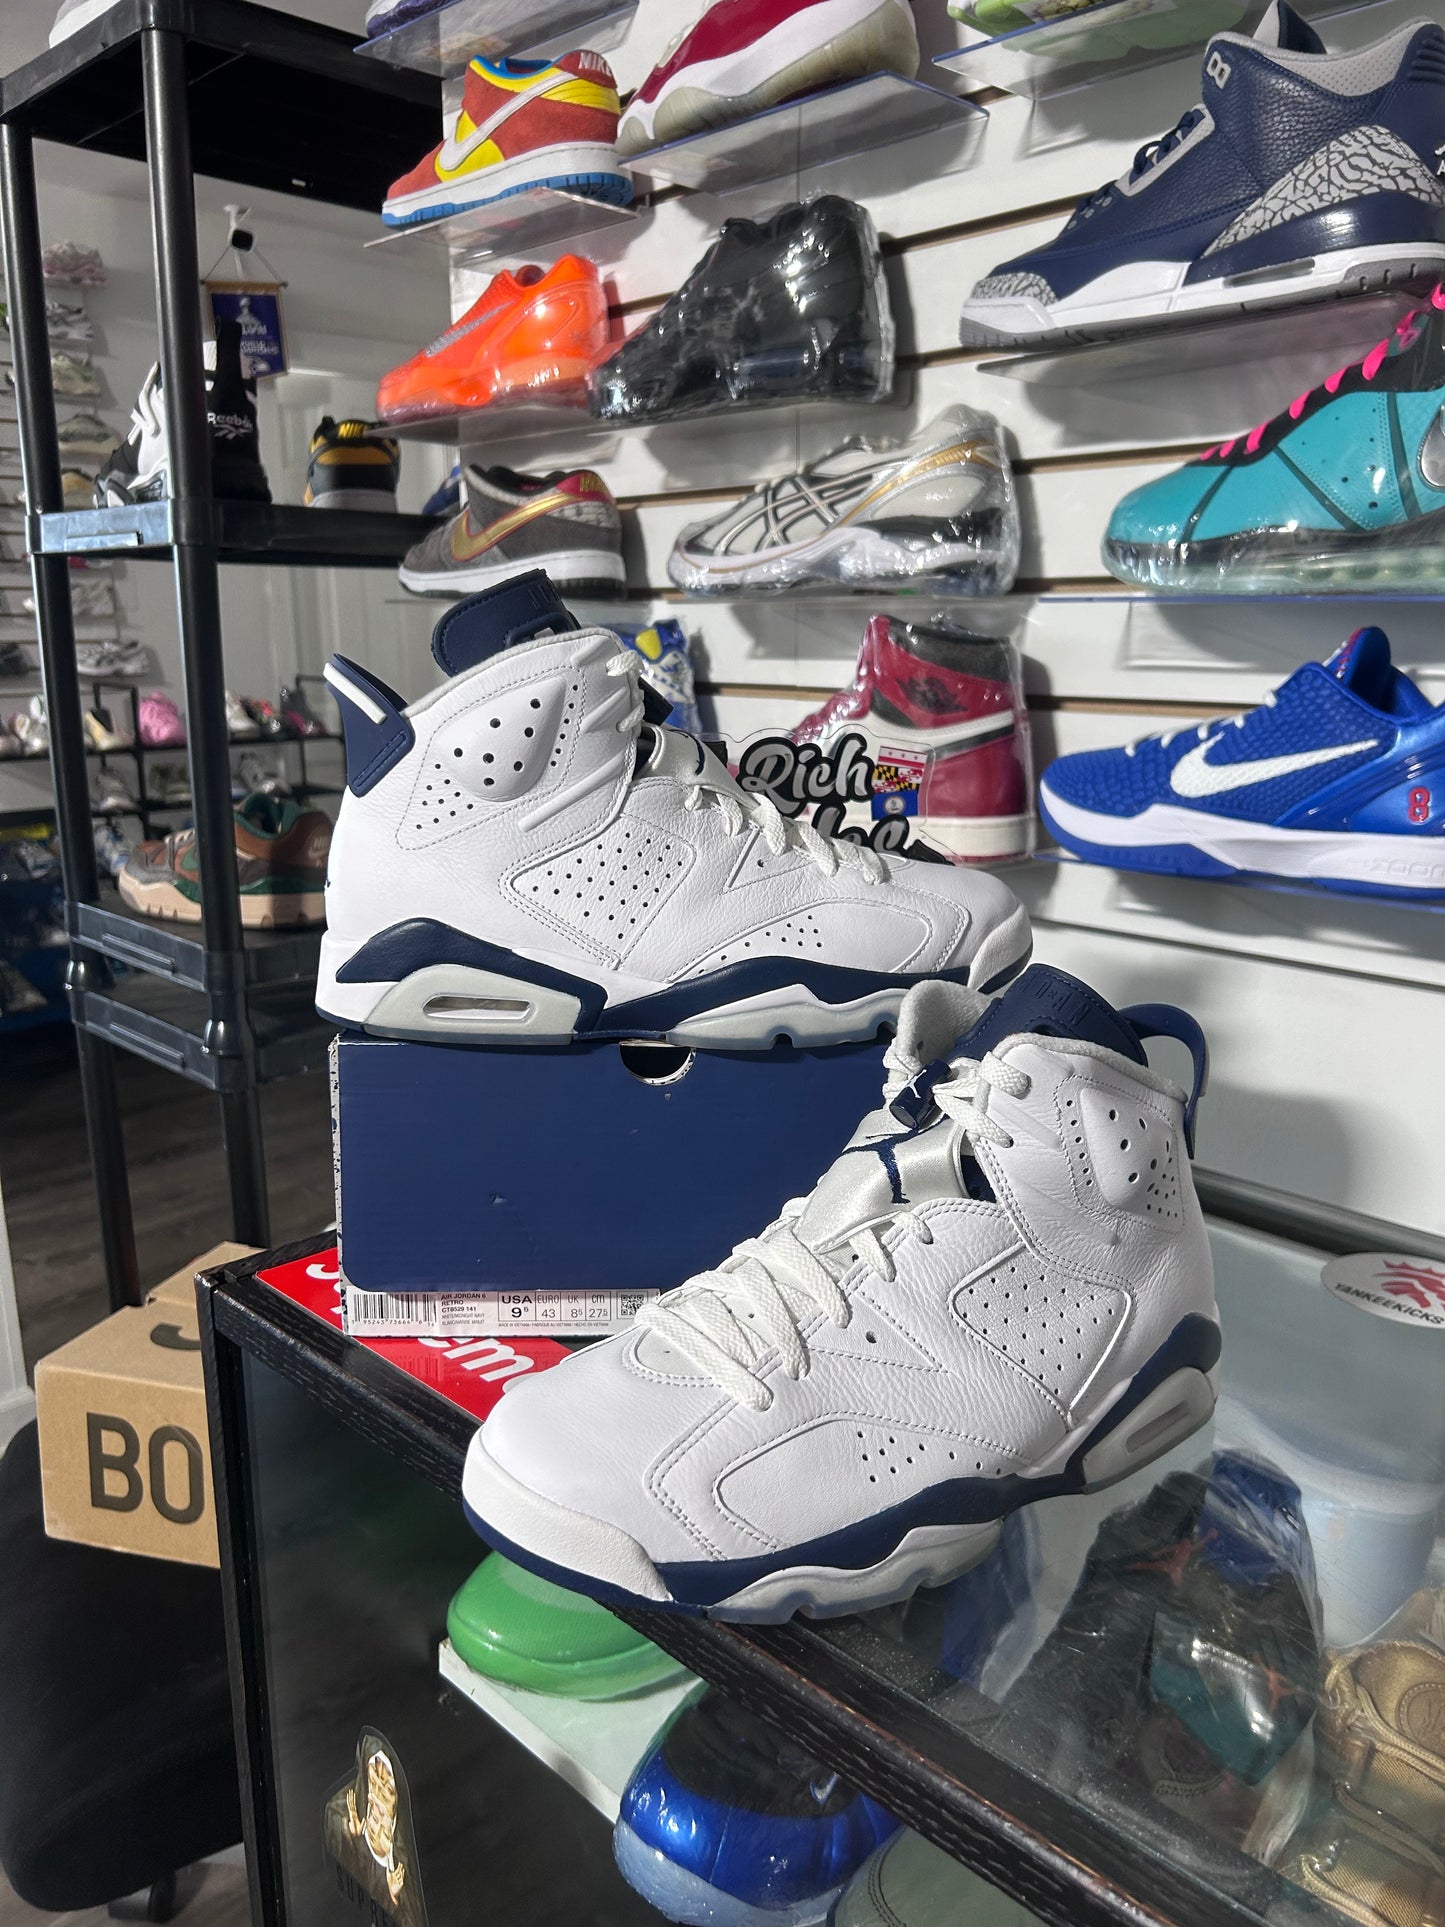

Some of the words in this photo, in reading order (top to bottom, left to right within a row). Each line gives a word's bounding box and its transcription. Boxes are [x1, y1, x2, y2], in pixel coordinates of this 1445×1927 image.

[578, 51, 612, 77] NIKE
[738, 734, 874, 817] Rich
[501, 1295, 533, 1304] USA
[537, 1294, 560, 1304] EURO
[567, 1294, 580, 1304] UK
[1334, 1281, 1444, 1325] YANKEEKICKS
[541, 1308, 556, 1318] 43
